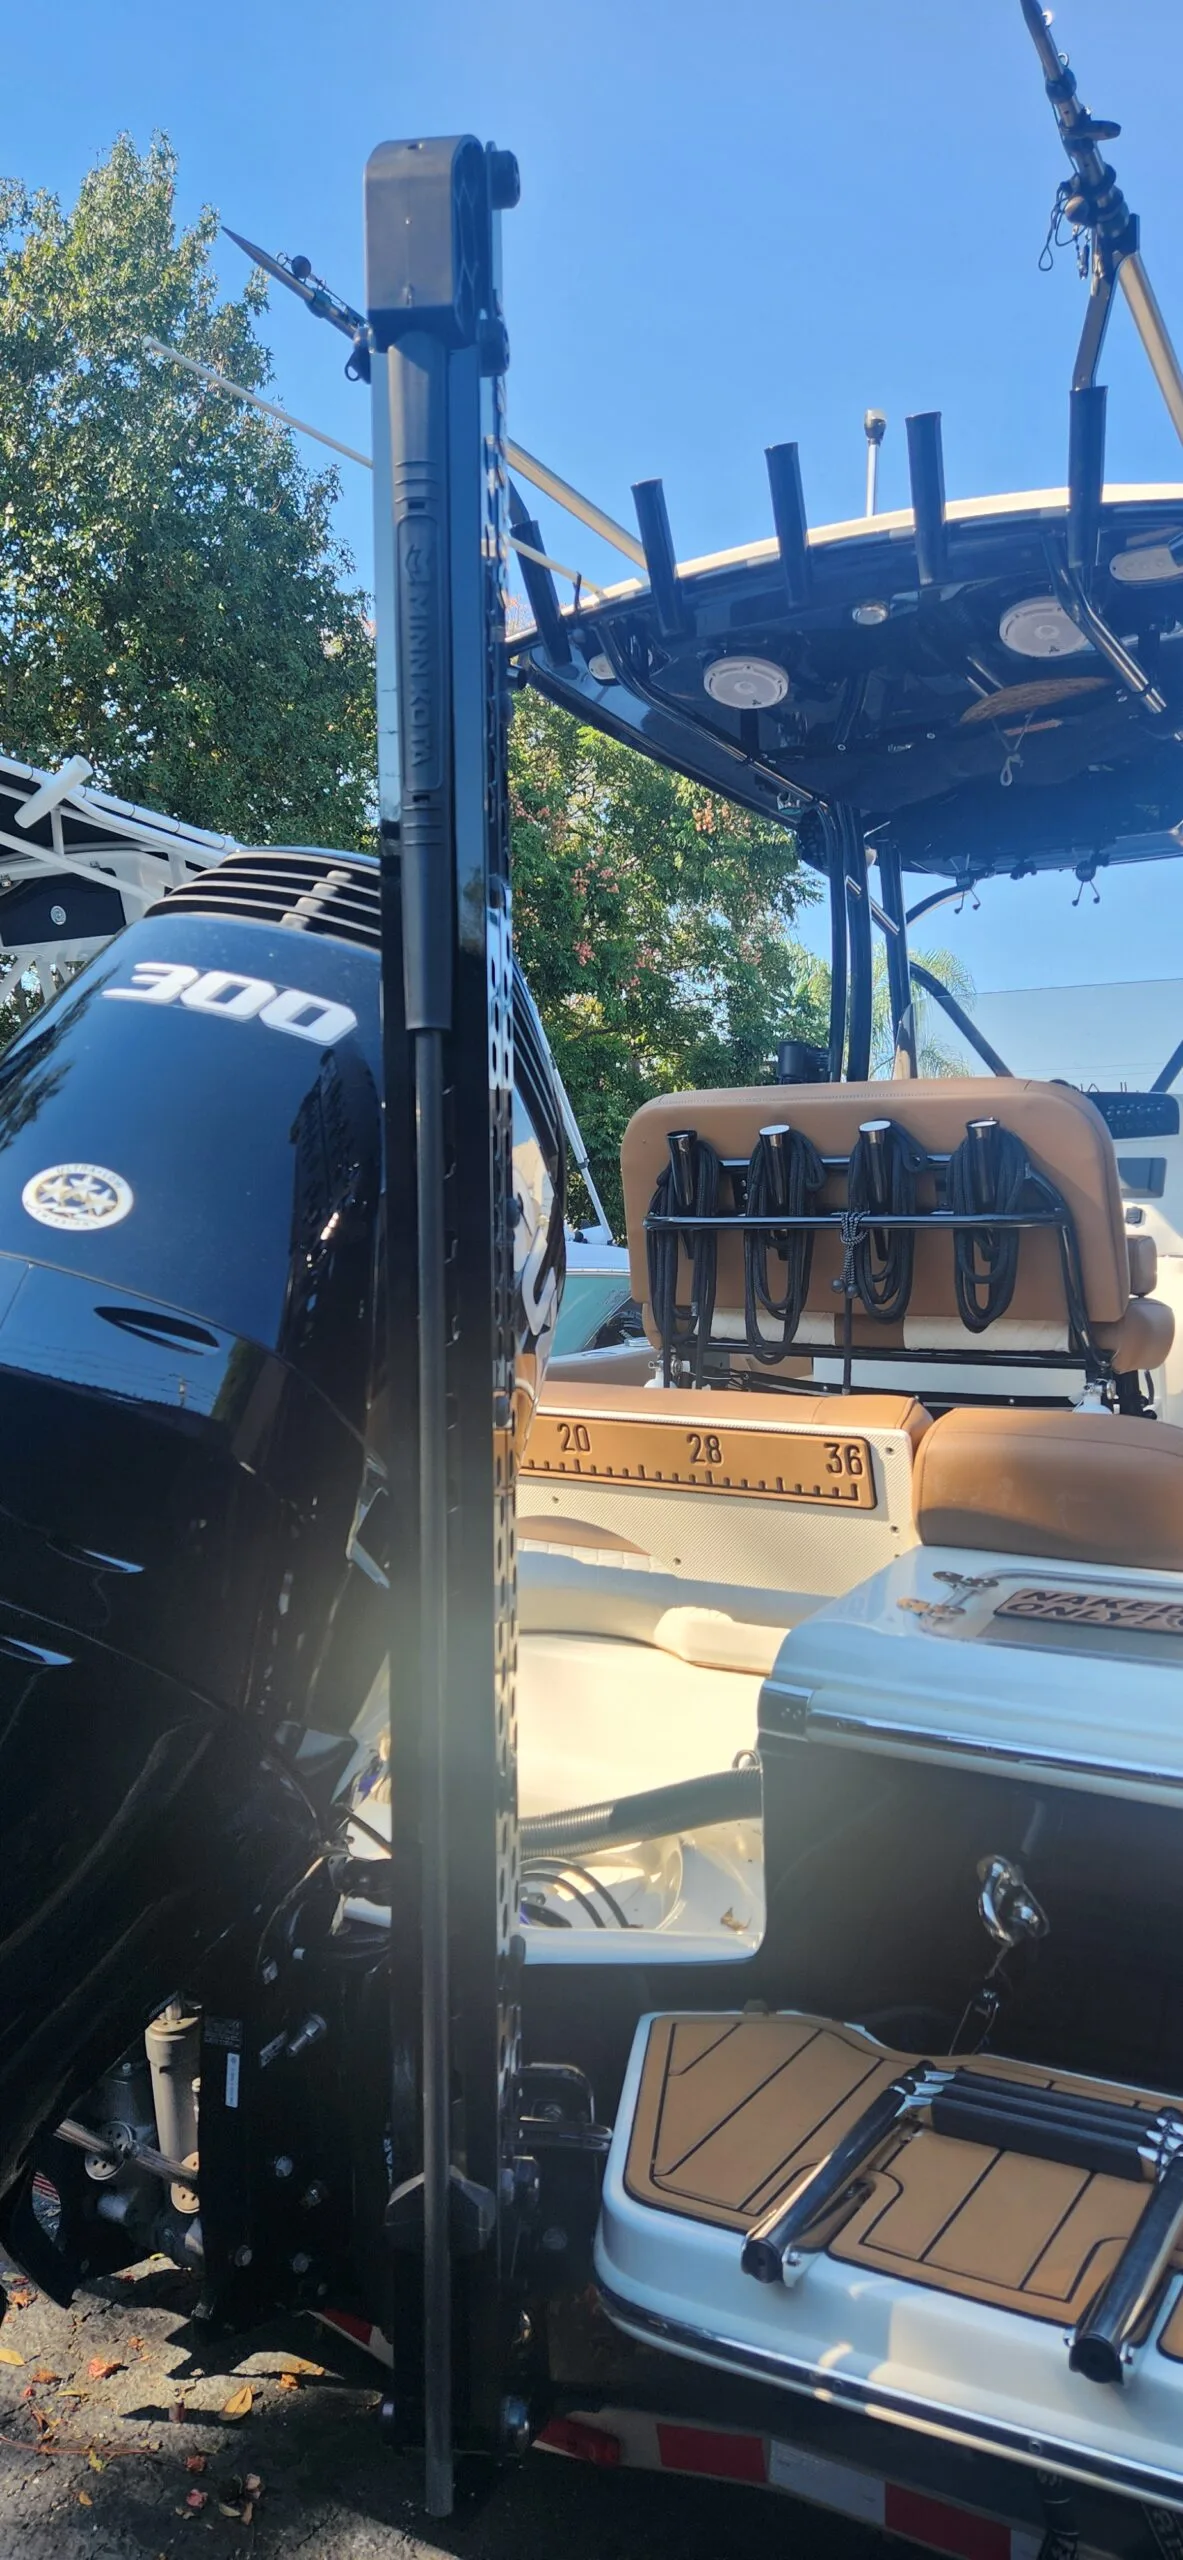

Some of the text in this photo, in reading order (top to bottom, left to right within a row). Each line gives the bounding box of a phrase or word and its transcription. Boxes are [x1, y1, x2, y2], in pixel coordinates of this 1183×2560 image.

[409, 592, 432, 768] MINN KOTA
[101, 962, 358, 1046] 300
[557, 1423, 863, 1477] 20 28 36
